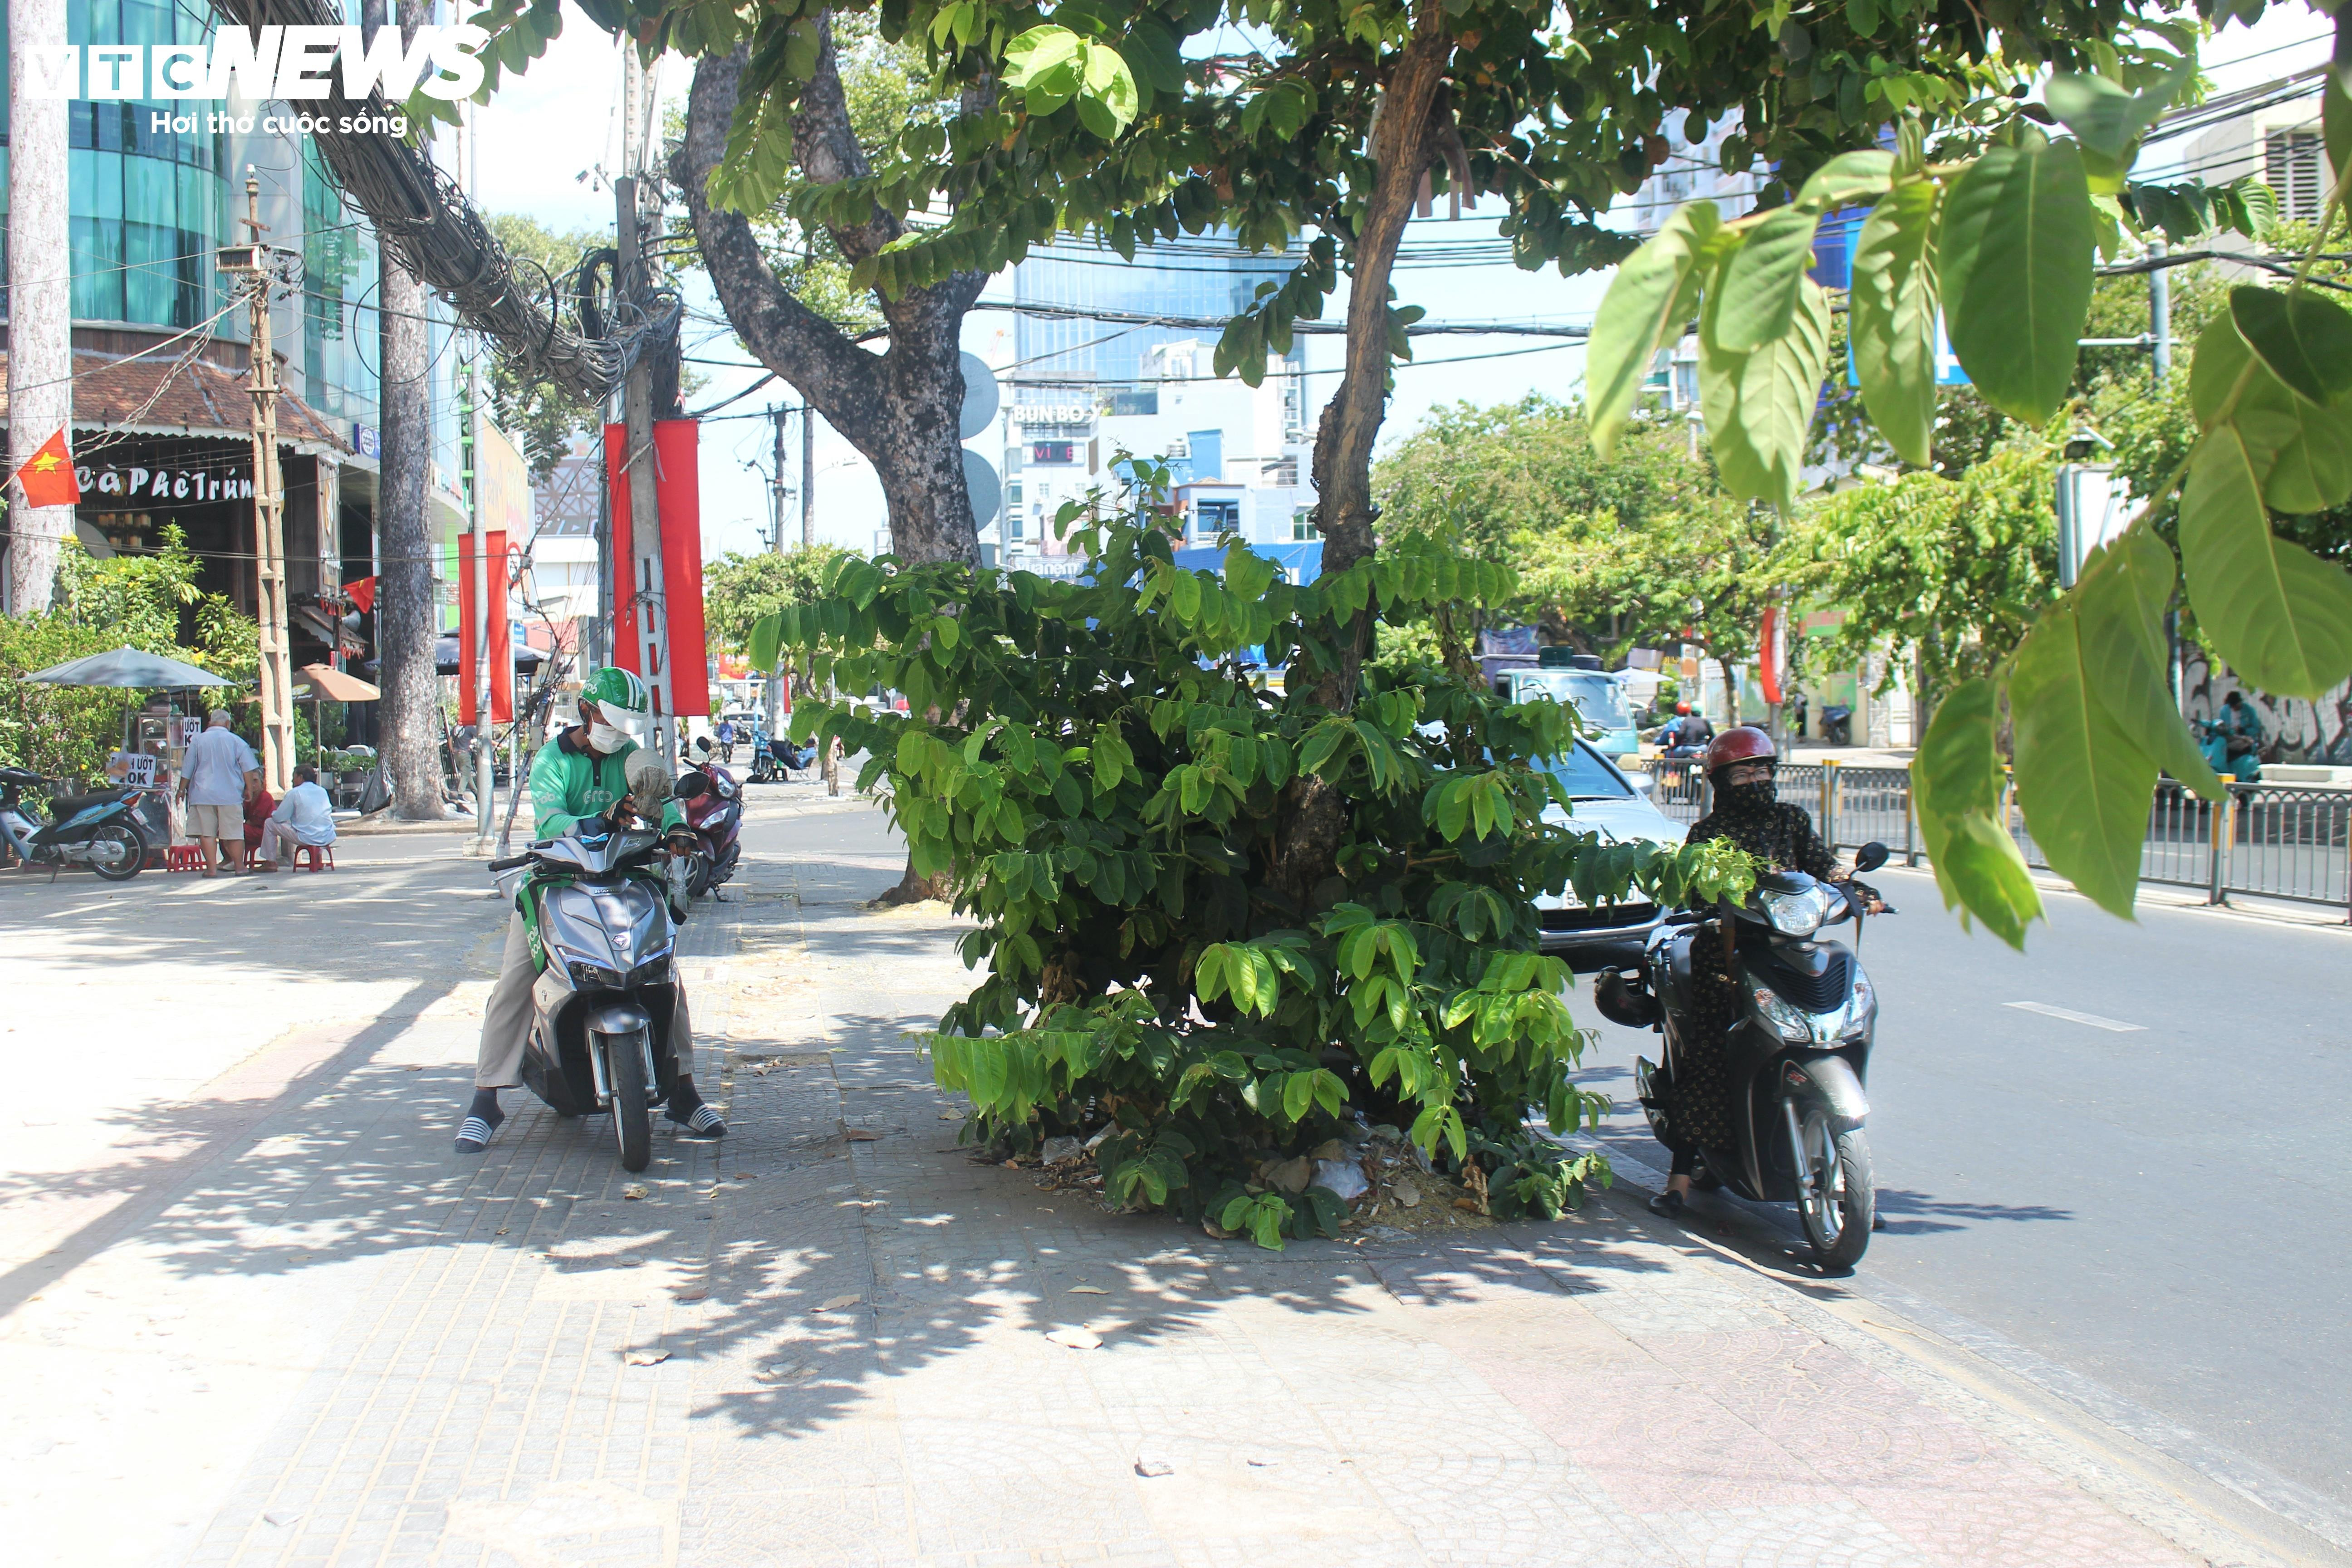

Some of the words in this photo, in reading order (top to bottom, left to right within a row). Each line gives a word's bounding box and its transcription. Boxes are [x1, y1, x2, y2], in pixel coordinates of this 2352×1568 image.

[1014, 399, 1053, 423] BÚN
[1056, 399, 1084, 423] BÒ
[129, 468, 190, 499] Phê
